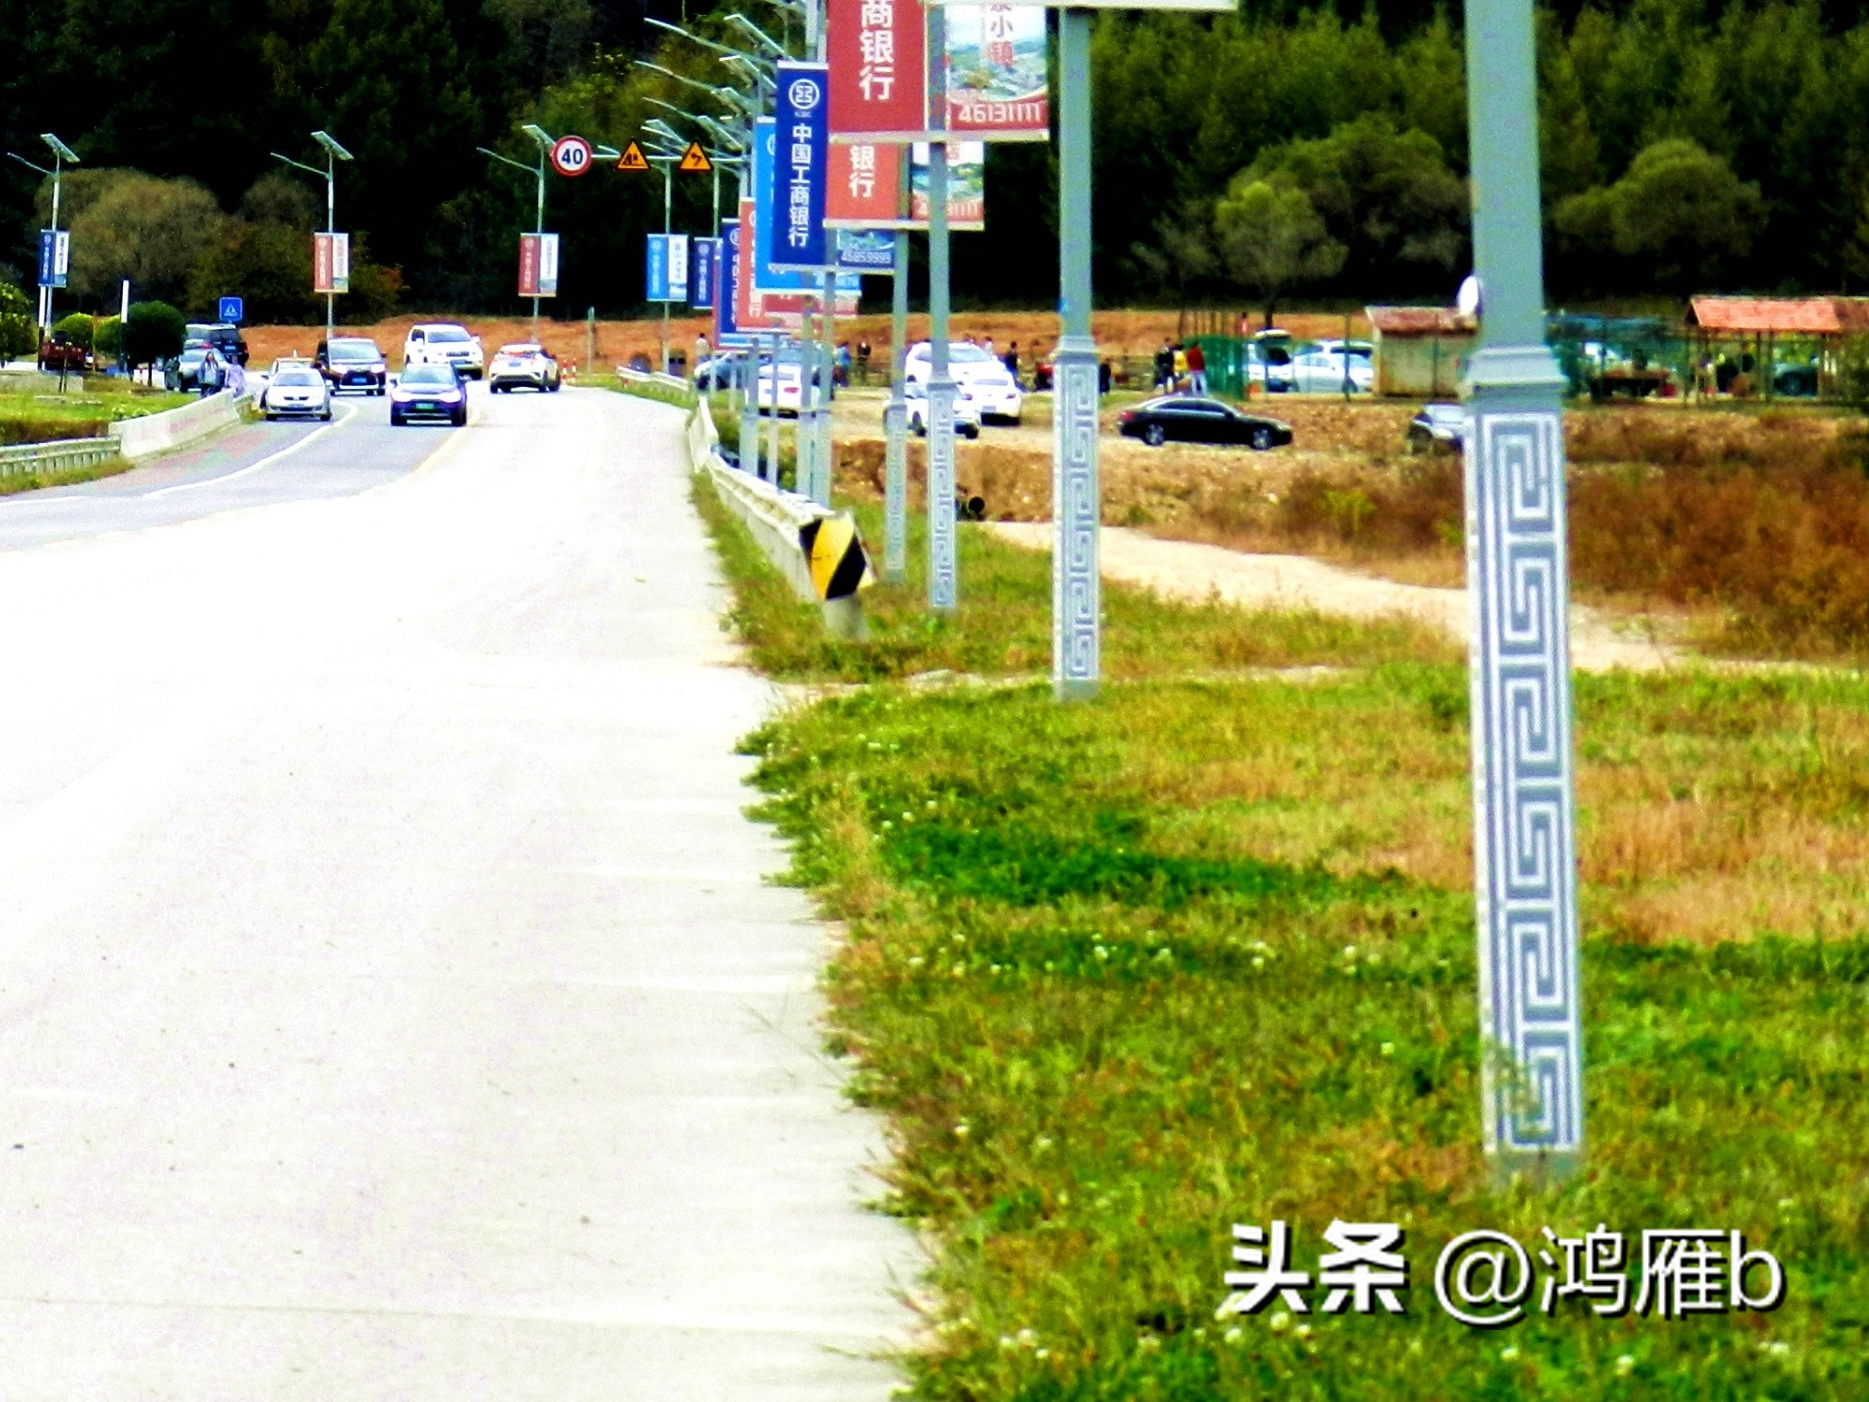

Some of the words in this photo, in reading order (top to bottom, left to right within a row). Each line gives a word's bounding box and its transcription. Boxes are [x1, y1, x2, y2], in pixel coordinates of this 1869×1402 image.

[561, 149, 583, 165] 40
[788, 123, 812, 247] 中国工商银行
